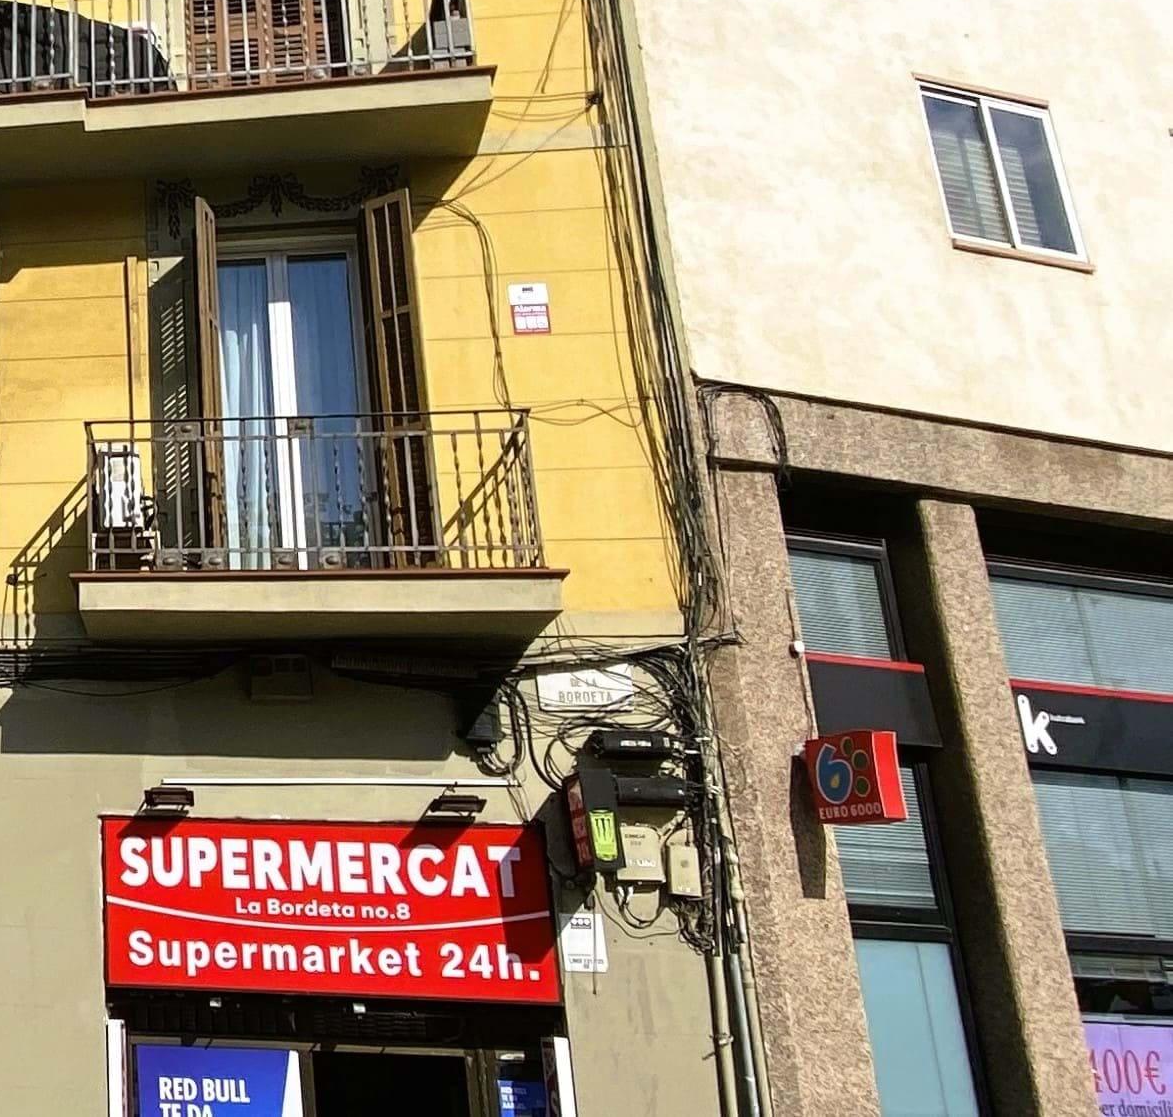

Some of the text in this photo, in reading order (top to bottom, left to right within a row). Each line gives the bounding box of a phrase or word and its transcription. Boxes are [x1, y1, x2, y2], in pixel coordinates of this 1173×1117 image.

[819, 802, 882, 820] EURO 6000
[119, 836, 521, 898] SUPERMERCAT
[236, 897, 410, 921] La Bordeta no.8
[128, 929, 540, 981] Supermarket 24h.
[159, 1076, 251, 1104] RED BULL
